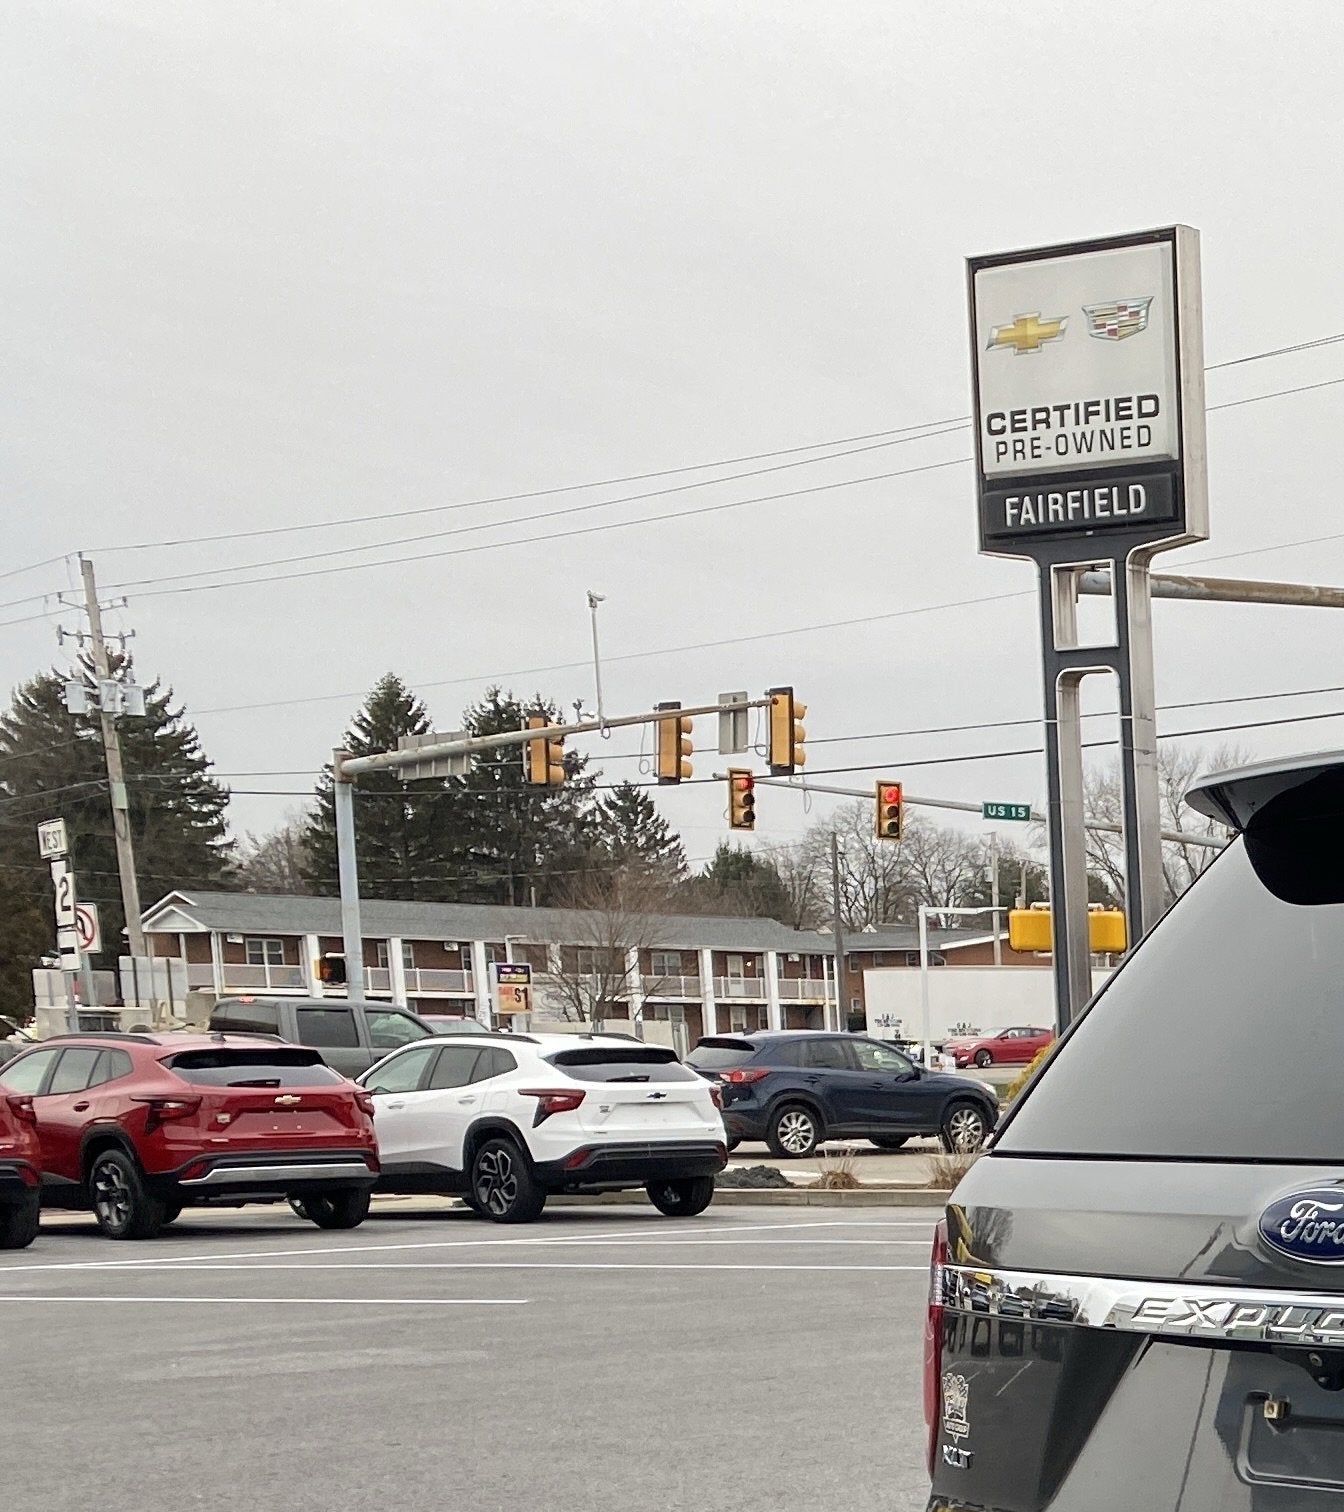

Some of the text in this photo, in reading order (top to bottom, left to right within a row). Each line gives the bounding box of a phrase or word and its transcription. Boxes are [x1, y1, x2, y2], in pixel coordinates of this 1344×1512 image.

[987, 394, 1160, 436] CERTIFIED
[996, 425, 1152, 463] PRE-OWNED
[1005, 484, 1147, 528] FAIRFIELD
[987, 805, 1026, 818] US 15
[41, 829, 62, 850] WEST
